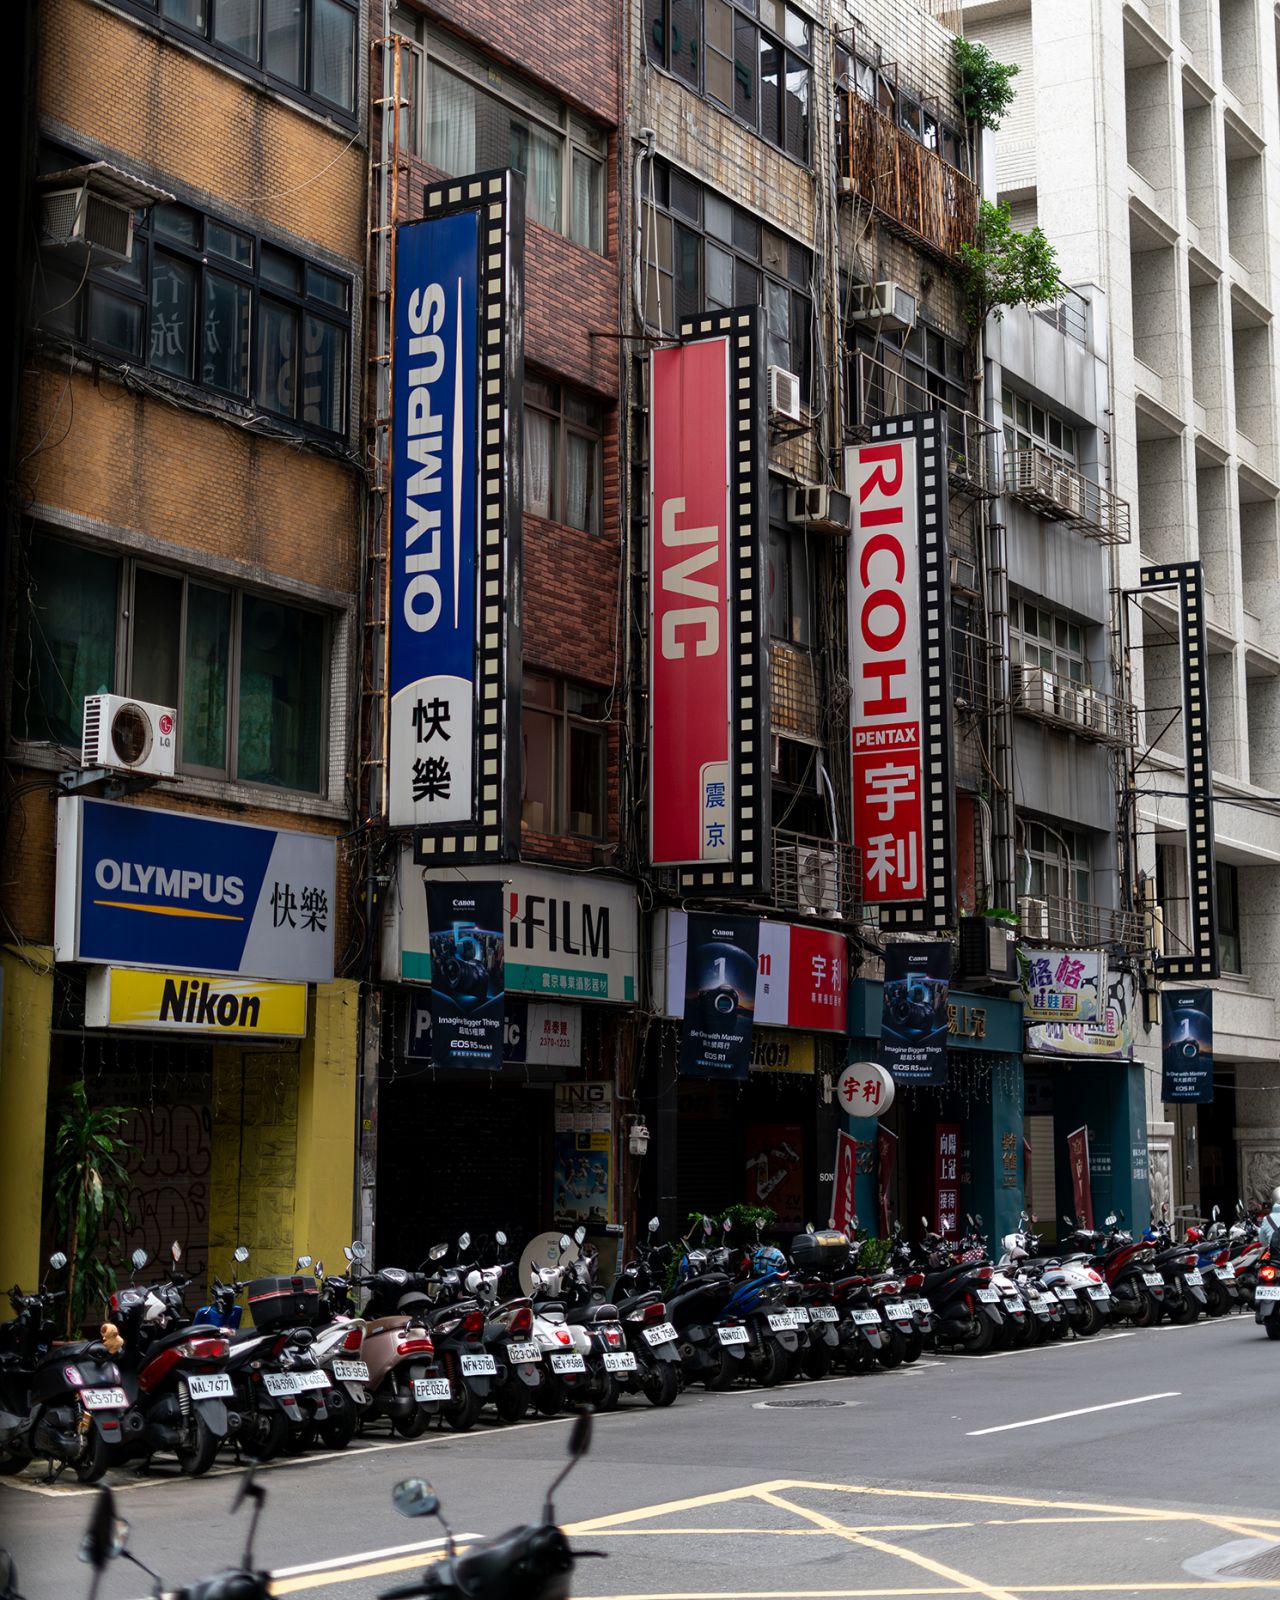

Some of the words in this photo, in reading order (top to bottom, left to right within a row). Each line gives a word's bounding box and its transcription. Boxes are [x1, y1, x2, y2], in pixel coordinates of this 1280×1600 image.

[404, 282, 446, 634] OLYMPUS
[662, 496, 719, 660] JVC
[858, 443, 906, 716] RICOH
[160, 738, 170, 747] LG
[856, 727, 916, 747] PENTAX
[412, 697, 451, 802] 快樂
[705, 782, 725, 847] 震京
[865, 762, 918, 892] 宇利
[95, 859, 244, 906] OLYMPUS
[271, 882, 328, 932] 快樂
[453, 899, 475, 907] Canon
[510, 893, 609, 959] IFILM
[712, 928, 734, 936] Canon
[811, 954, 841, 992] 宇利
[159, 979, 260, 1027] Nikon
[1034, 994, 1074, 1009] 娃娃屋
[450, 1040, 470, 1048] EOS
[704, 1052, 717, 1060] EOS
[843, 1076, 882, 1105] 宇利
[819, 1173, 834, 1182] SON
[463, 1359, 494, 1371] NFN-3780
[85, 1392, 124, 1405] MCS-5729
[191, 1380, 229, 1394] NAL-7677
[416, 1384, 449, 1396] EPE-0326
